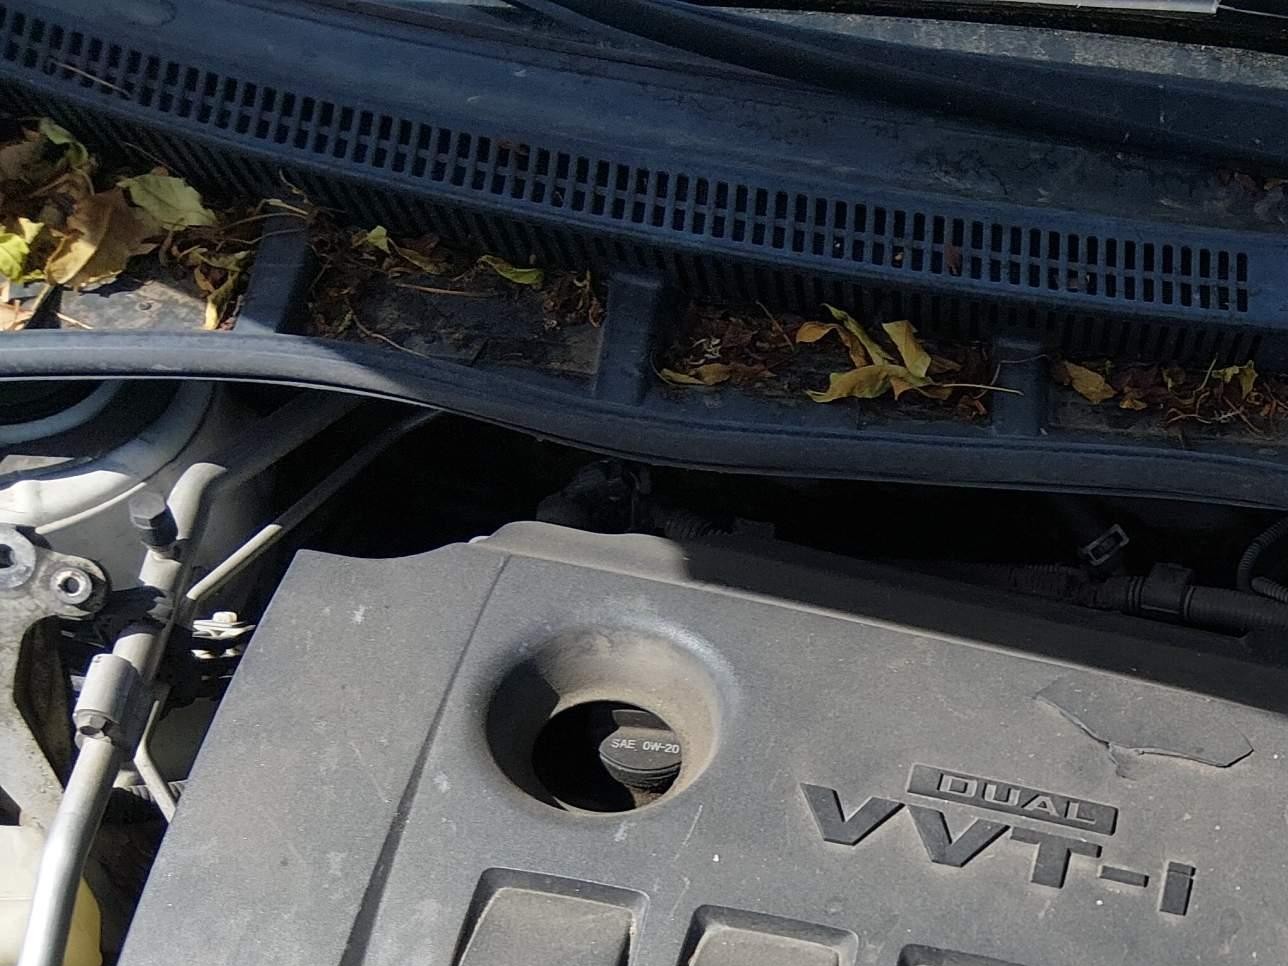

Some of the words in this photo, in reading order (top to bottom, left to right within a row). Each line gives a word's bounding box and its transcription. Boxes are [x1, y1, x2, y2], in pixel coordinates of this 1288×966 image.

[610, 739, 637, 750] SAE
[642, 741, 680, 754] 0W-20
[937, 773, 1097, 825] DUAL
[800, 782, 1197, 917] VVT-i
